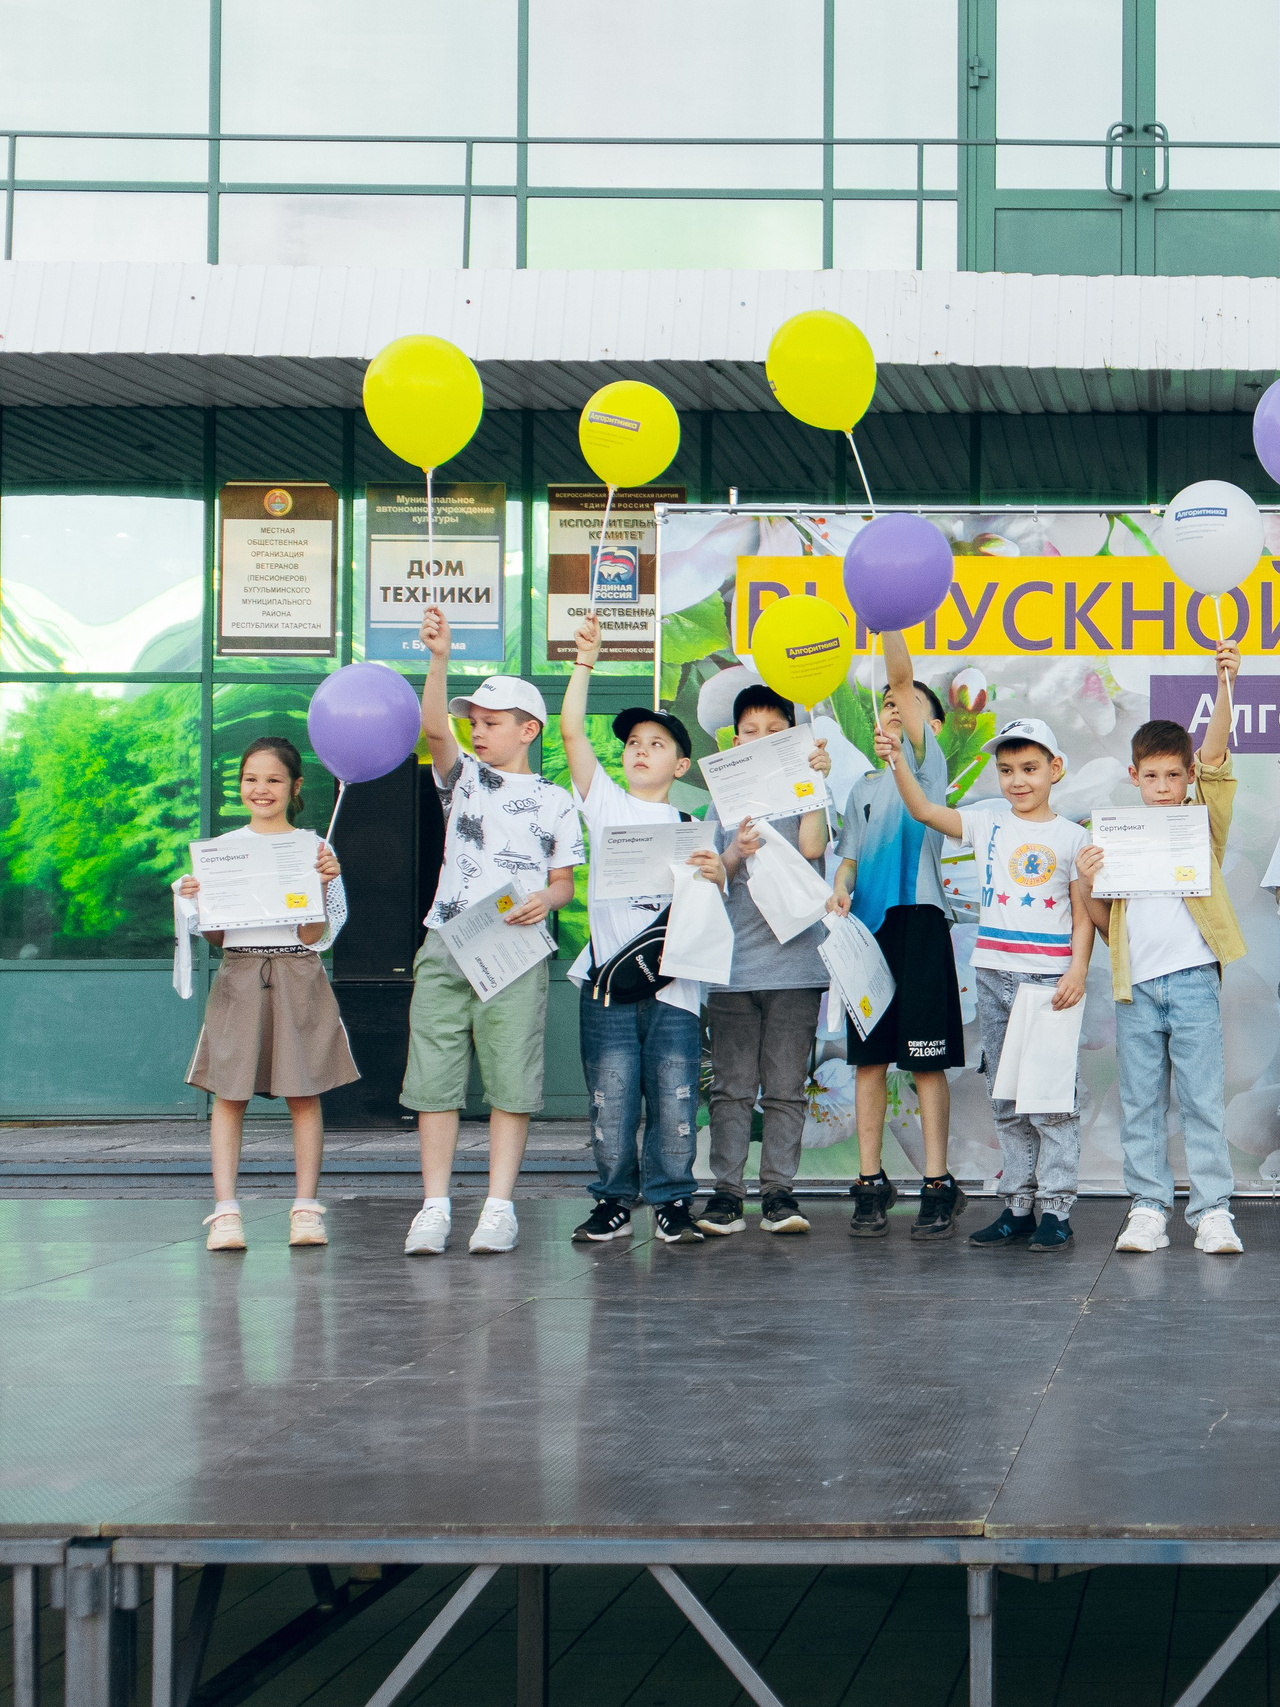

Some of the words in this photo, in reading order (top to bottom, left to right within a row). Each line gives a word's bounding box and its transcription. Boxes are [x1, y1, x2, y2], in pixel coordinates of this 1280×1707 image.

[436, 506, 495, 514] учреждение
[1177, 508, 1226, 518] Алгоритмика
[412, 515, 459, 523] културы
[246, 539, 309, 547] ОБЩЕСТВЕННАЯ
[250, 551, 305, 559] ОРГАНИЗАЦИЯ
[407, 559, 465, 580] ДОМ
[247, 575, 307, 583] (ПЕНСИОНЕРОВ)
[243, 586, 311, 594] БУГУЛЬМИНСКОГО
[595, 584, 633, 592] ЕДИНАЯ
[379, 586, 491, 604] ТЕХНИКИ
[595, 591, 633, 599] РОССИЯ
[241, 598, 312, 606] МУНИЦИПАЛЬНОГО
[261, 609, 292, 617] РАЙОНА
[231, 621, 279, 629] РЕСПУБЛИКИ
[789, 640, 839, 656] Алгоритмика
[709, 755, 753, 774] Сертификат
[1099, 824, 1145, 832] Сертификат
[607, 836, 653, 844] Сертификат
[200, 853, 250, 864] Сертификат
